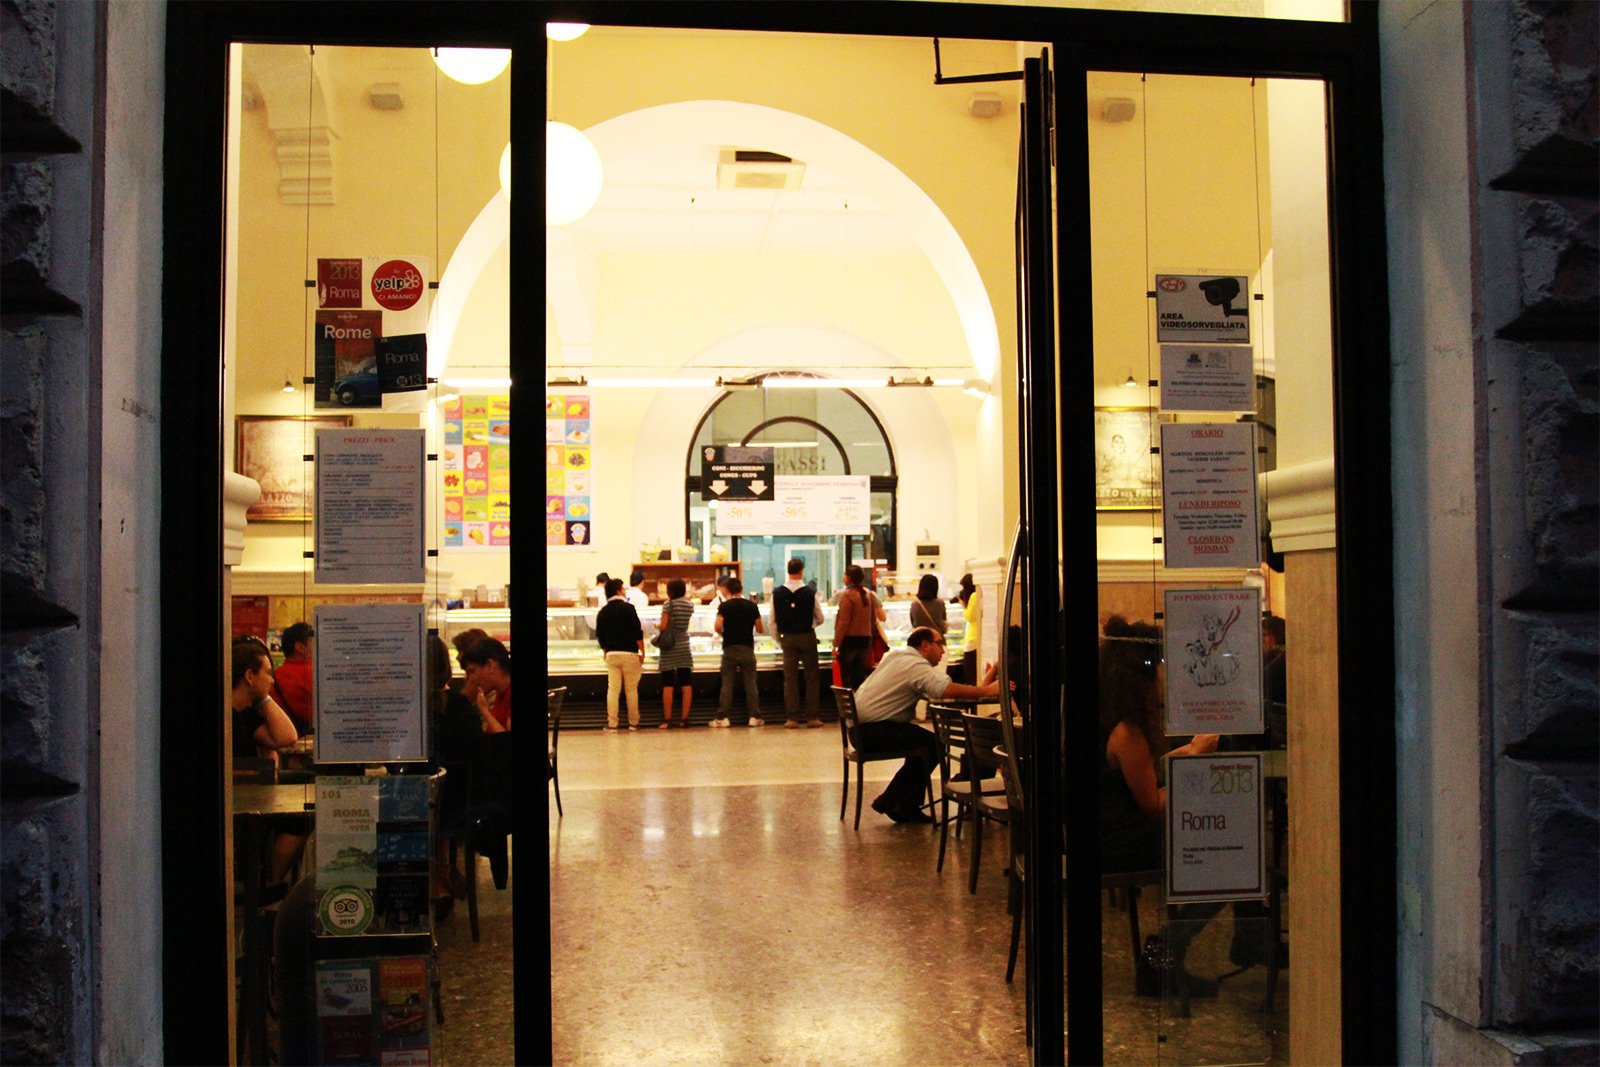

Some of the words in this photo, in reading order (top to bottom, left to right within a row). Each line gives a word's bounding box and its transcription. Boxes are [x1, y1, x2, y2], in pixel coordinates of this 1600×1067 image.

[330, 264, 360, 280] 2013
[374, 276, 405, 292] yelp
[330, 286, 360, 299] Roma
[1160, 321, 1246, 329] VIDEOSORVEGLIATA
[324, 325, 372, 339] Rome
[385, 352, 419, 364] Roma
[1191, 429, 1223, 438] ORARIO
[1211, 500, 1241, 509] RIPOSO
[1188, 536, 1220, 544] CLOSED
[1193, 545, 1229, 553] MONDAY
[1210, 770, 1254, 794] 2013
[321, 791, 341, 801] 101
[333, 808, 371, 817] ROMA
[1181, 811, 1226, 831] Roma
